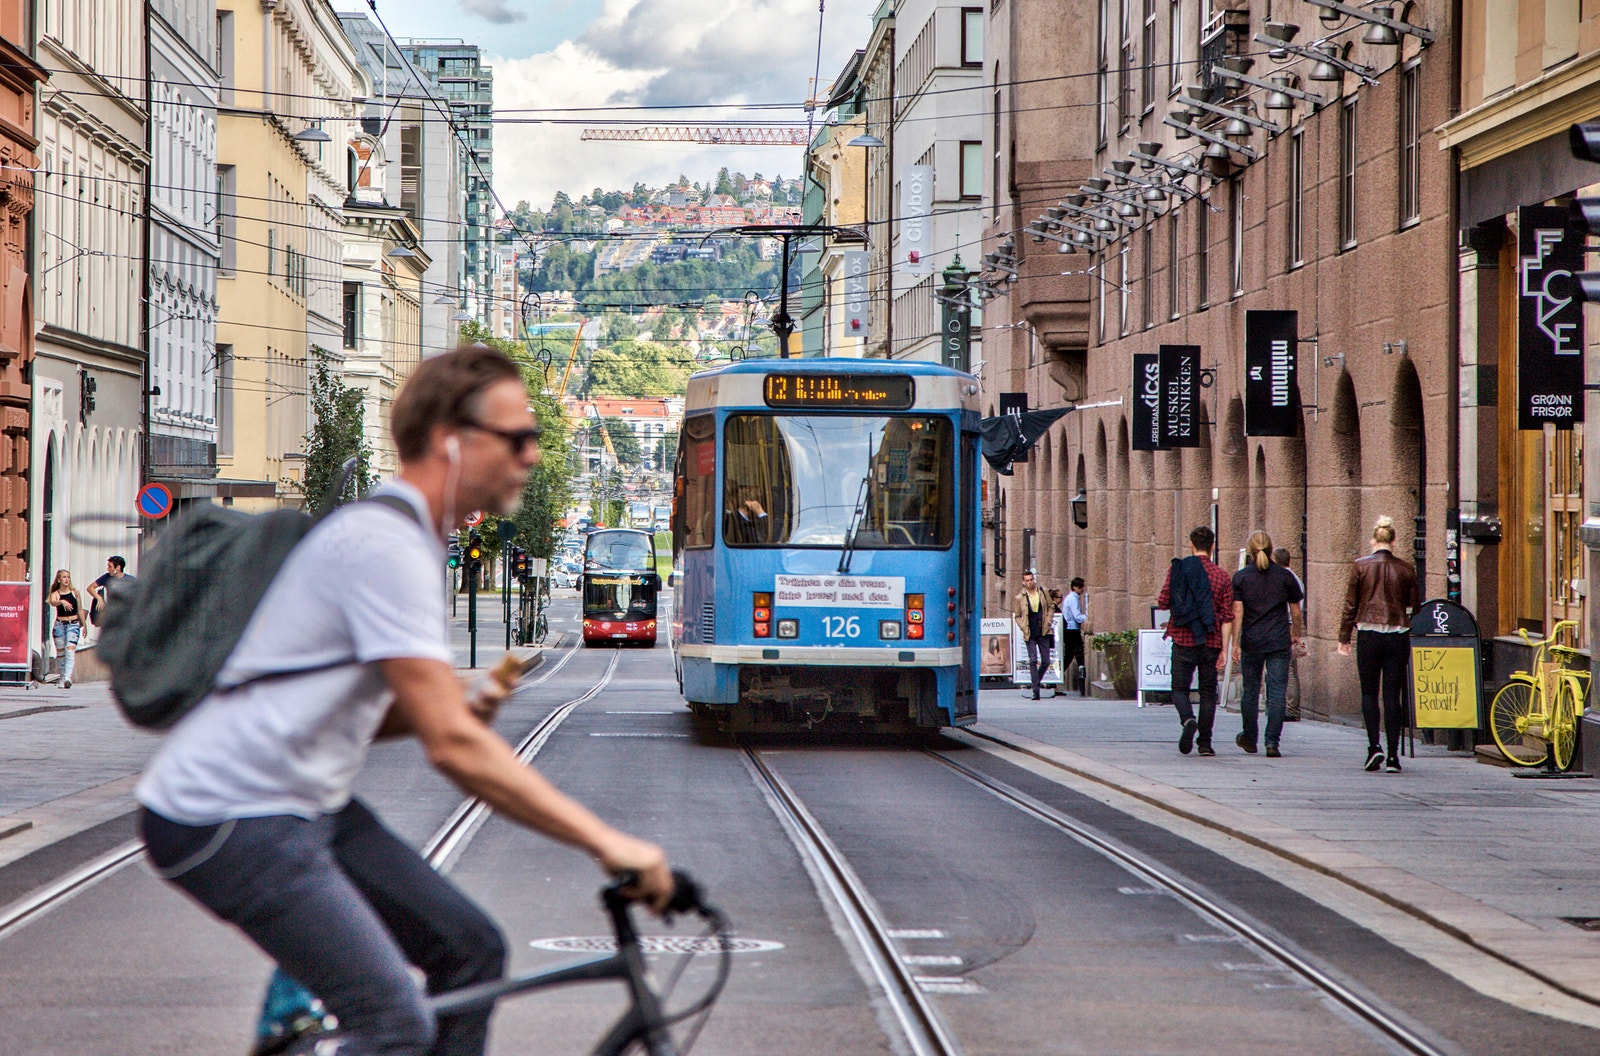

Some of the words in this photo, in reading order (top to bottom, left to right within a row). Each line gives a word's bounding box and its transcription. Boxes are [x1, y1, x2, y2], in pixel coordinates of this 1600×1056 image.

[907, 173, 924, 243] Citybox
[849, 257, 864, 313] Citybox
[1271, 340, 1294, 407] minimum
[1168, 376, 1179, 437] MUSKEL
[1180, 356, 1192, 437] KLINIKKEN
[1531, 394, 1572, 405] GRØNN
[1531, 406, 1572, 417] FRISØR
[821, 615, 861, 638] 126
[1145, 664, 1170, 676] SAL
[1416, 650, 1448, 672] 15%
